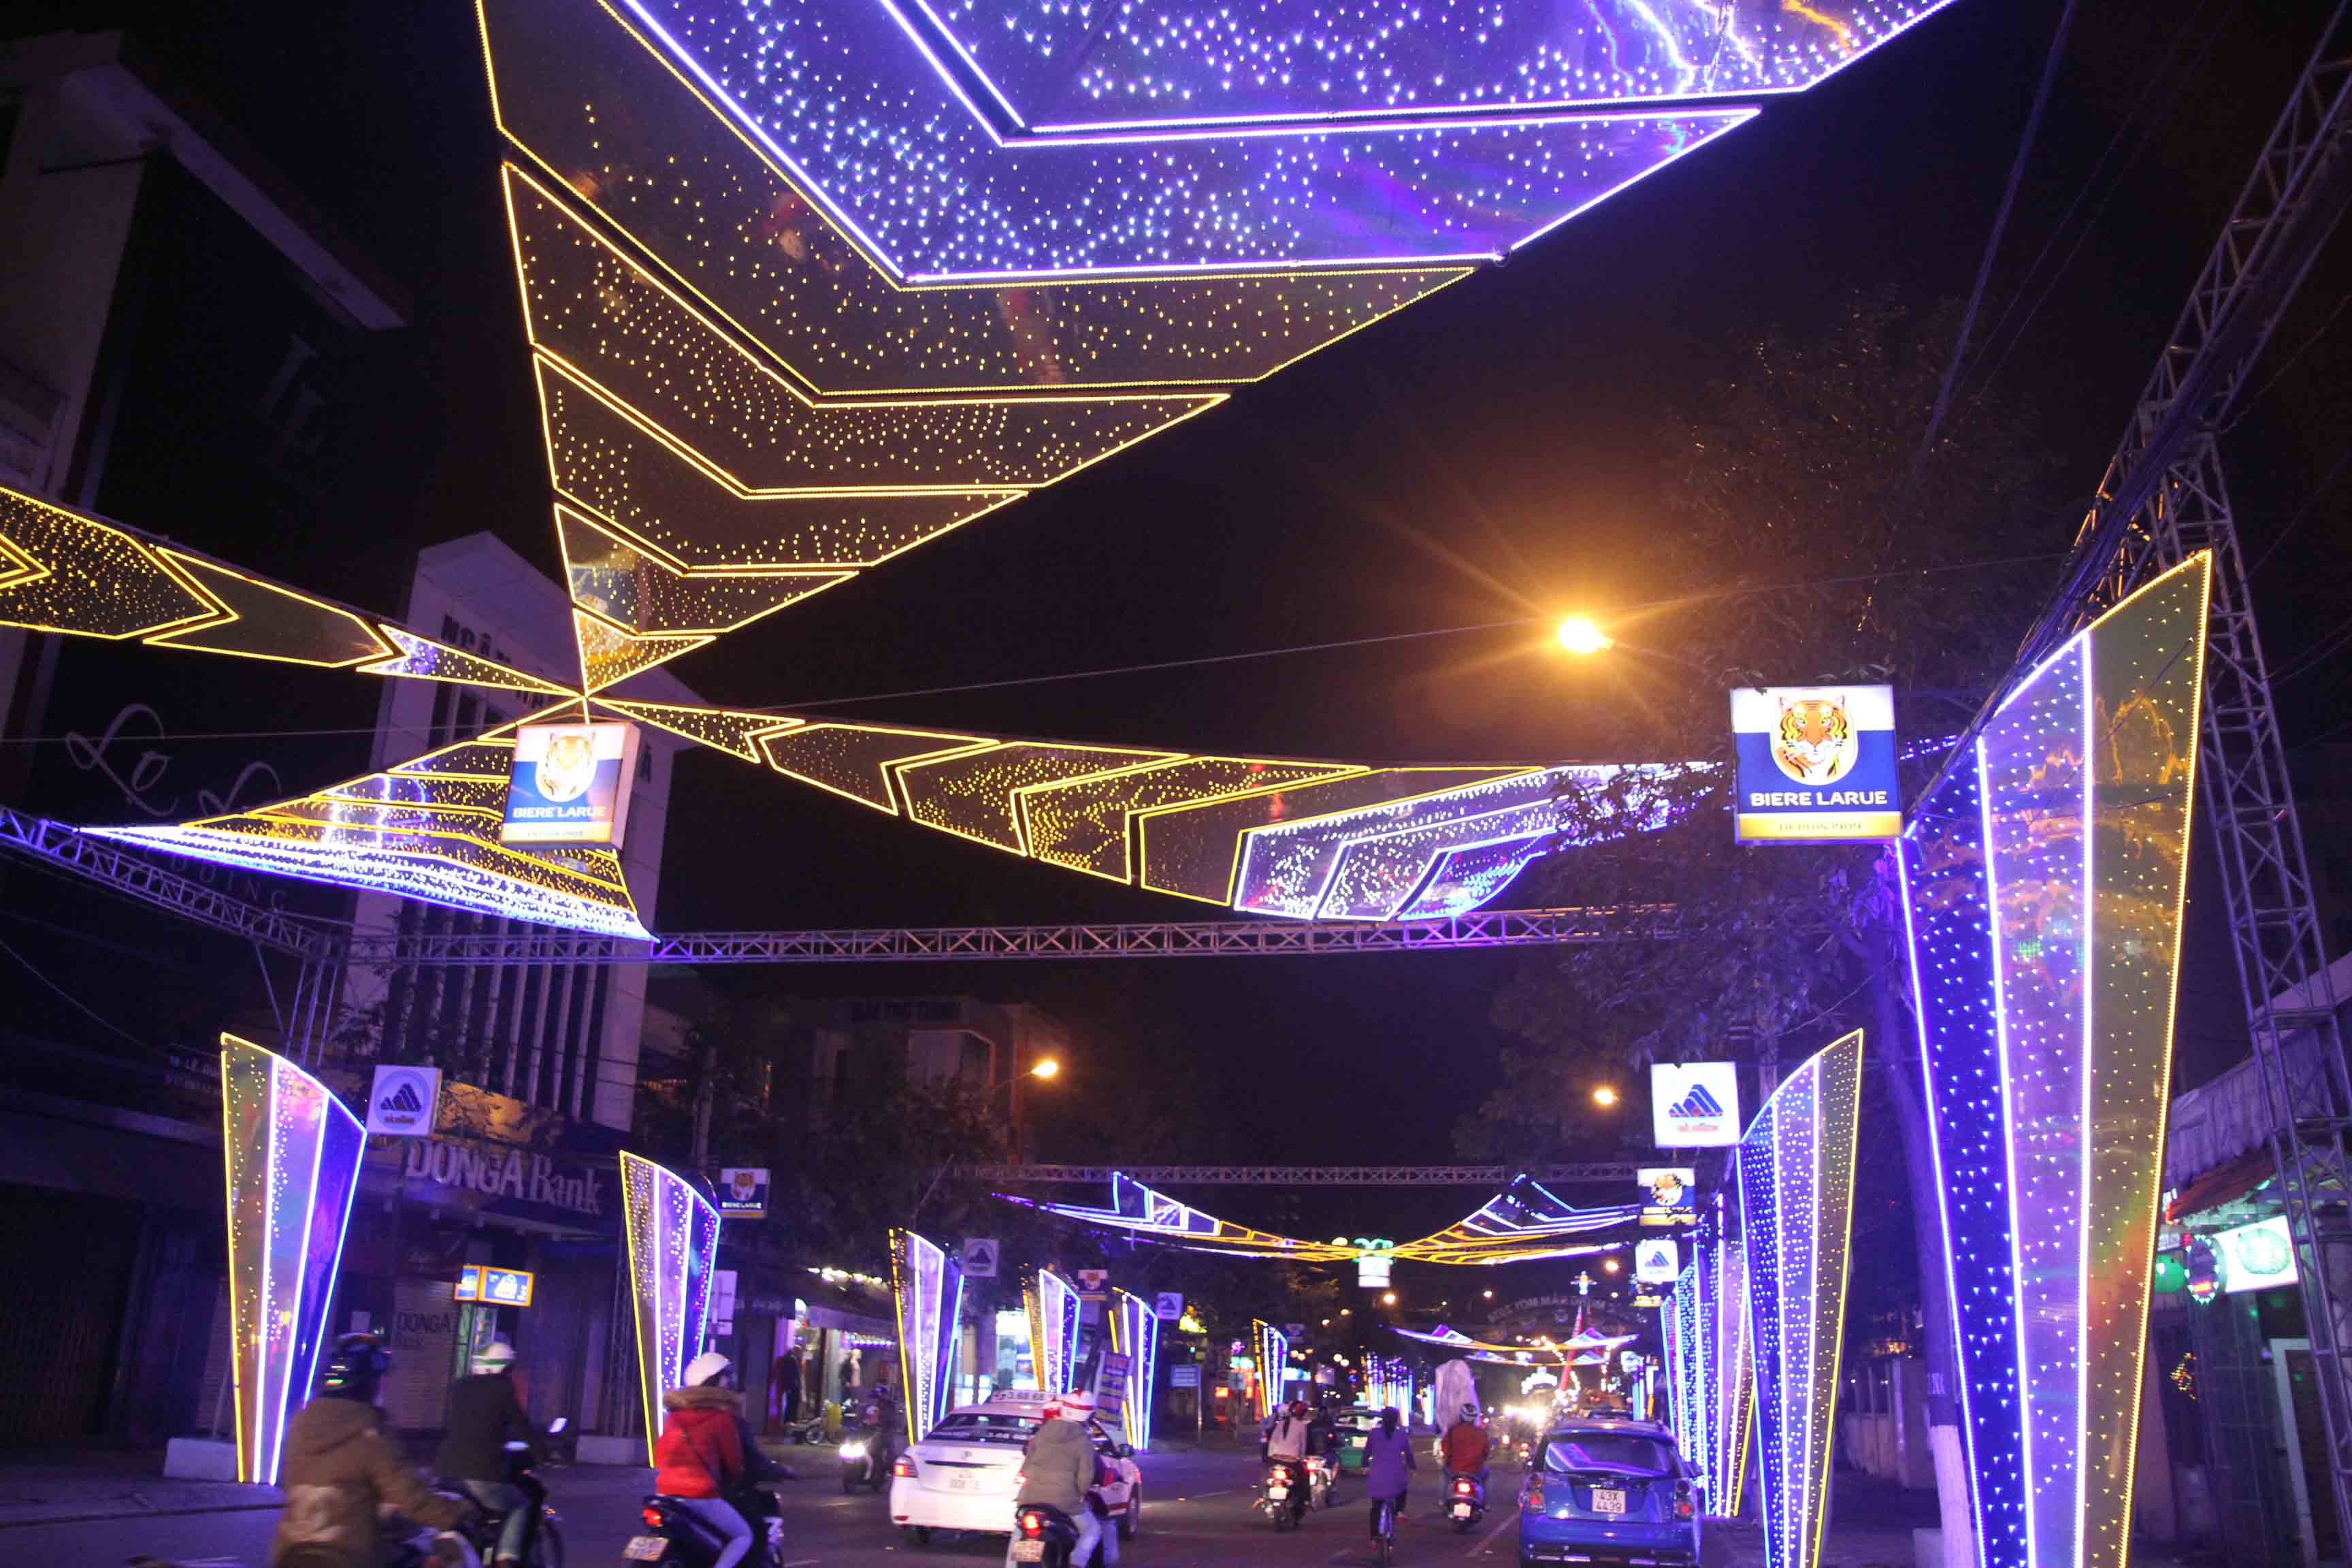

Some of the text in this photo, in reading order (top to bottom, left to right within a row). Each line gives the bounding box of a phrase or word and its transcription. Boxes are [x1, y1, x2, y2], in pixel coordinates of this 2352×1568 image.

[1750, 790, 1888, 806] BIERE LARUE
[512, 806, 606, 819] BIERE LARUE
[404, 1140, 603, 1215] DONGA Bank
